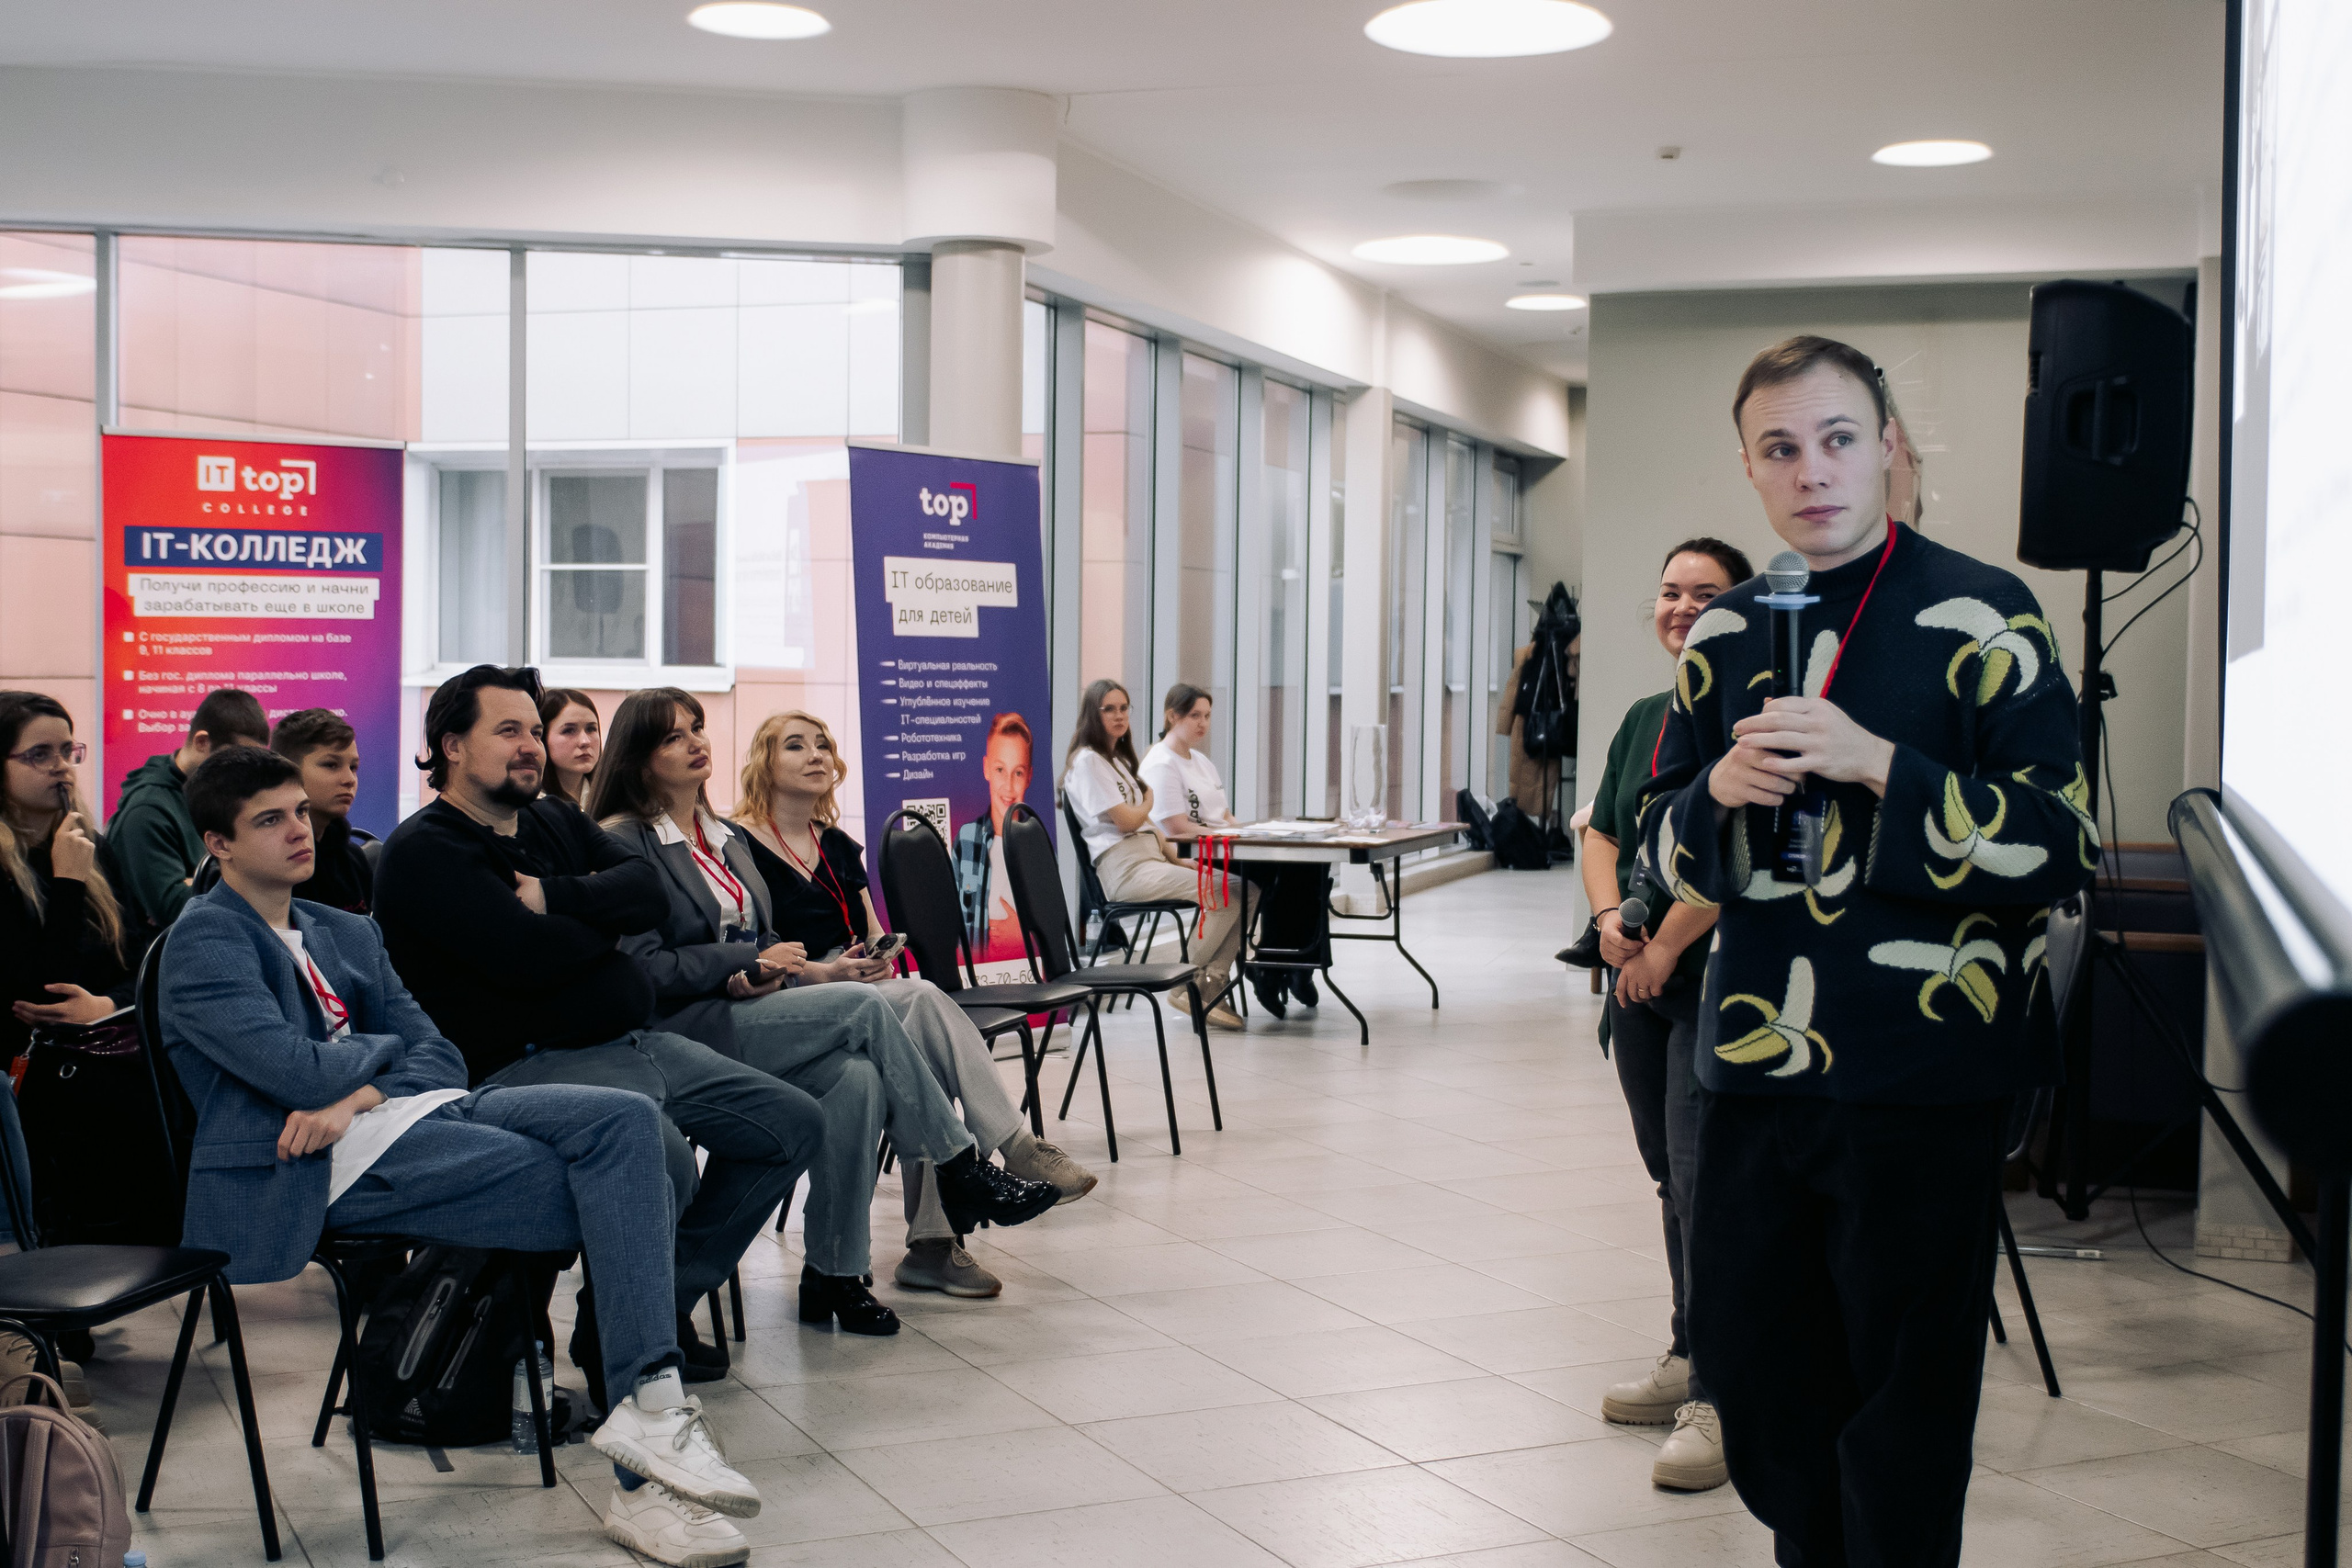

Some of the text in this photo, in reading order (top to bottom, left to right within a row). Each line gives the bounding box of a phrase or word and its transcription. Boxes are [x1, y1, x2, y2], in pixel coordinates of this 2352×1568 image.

[205, 465, 305, 500] IT top
[201, 502, 308, 516] COLLEGE
[920, 487, 968, 525] top
[923, 533, 969, 543] КОМПЬЮТЕРНАЯ
[141, 532, 367, 569] IT-КОЛЛЕДЖ
[923, 541, 955, 550] АКАДЕМИЯ
[140, 578, 369, 595] Получи профессию и начни
[891, 570, 1012, 593] IT образование
[144, 599, 365, 614] зарабатывать еще в школе
[899, 606, 972, 626] для детей
[139, 631, 352, 644] С государственным дипломом на базе
[153, 645, 164, 654] 11
[165, 646, 213, 655] классов
[898, 659, 998, 672] Виртуальная реальность
[138, 671, 347, 682] Без гос. диплома параллельно школе,
[138, 685, 186, 694] начиная
[187, 685, 195, 694] с
[899, 677, 988, 690] Видео и спецэффекты
[899, 695, 990, 708] Углублённое изучение
[138, 709, 168, 719] Очно
[169, 710, 177, 719] в
[900, 714, 982, 726] IT-специальностей
[138, 722, 176, 734] Выбор
[900, 732, 962, 743] Робототехника
[901, 750, 967, 763] Разработка игр
[903, 768, 933, 781] Дизайн
[639, 1373, 673, 1385] adidas
